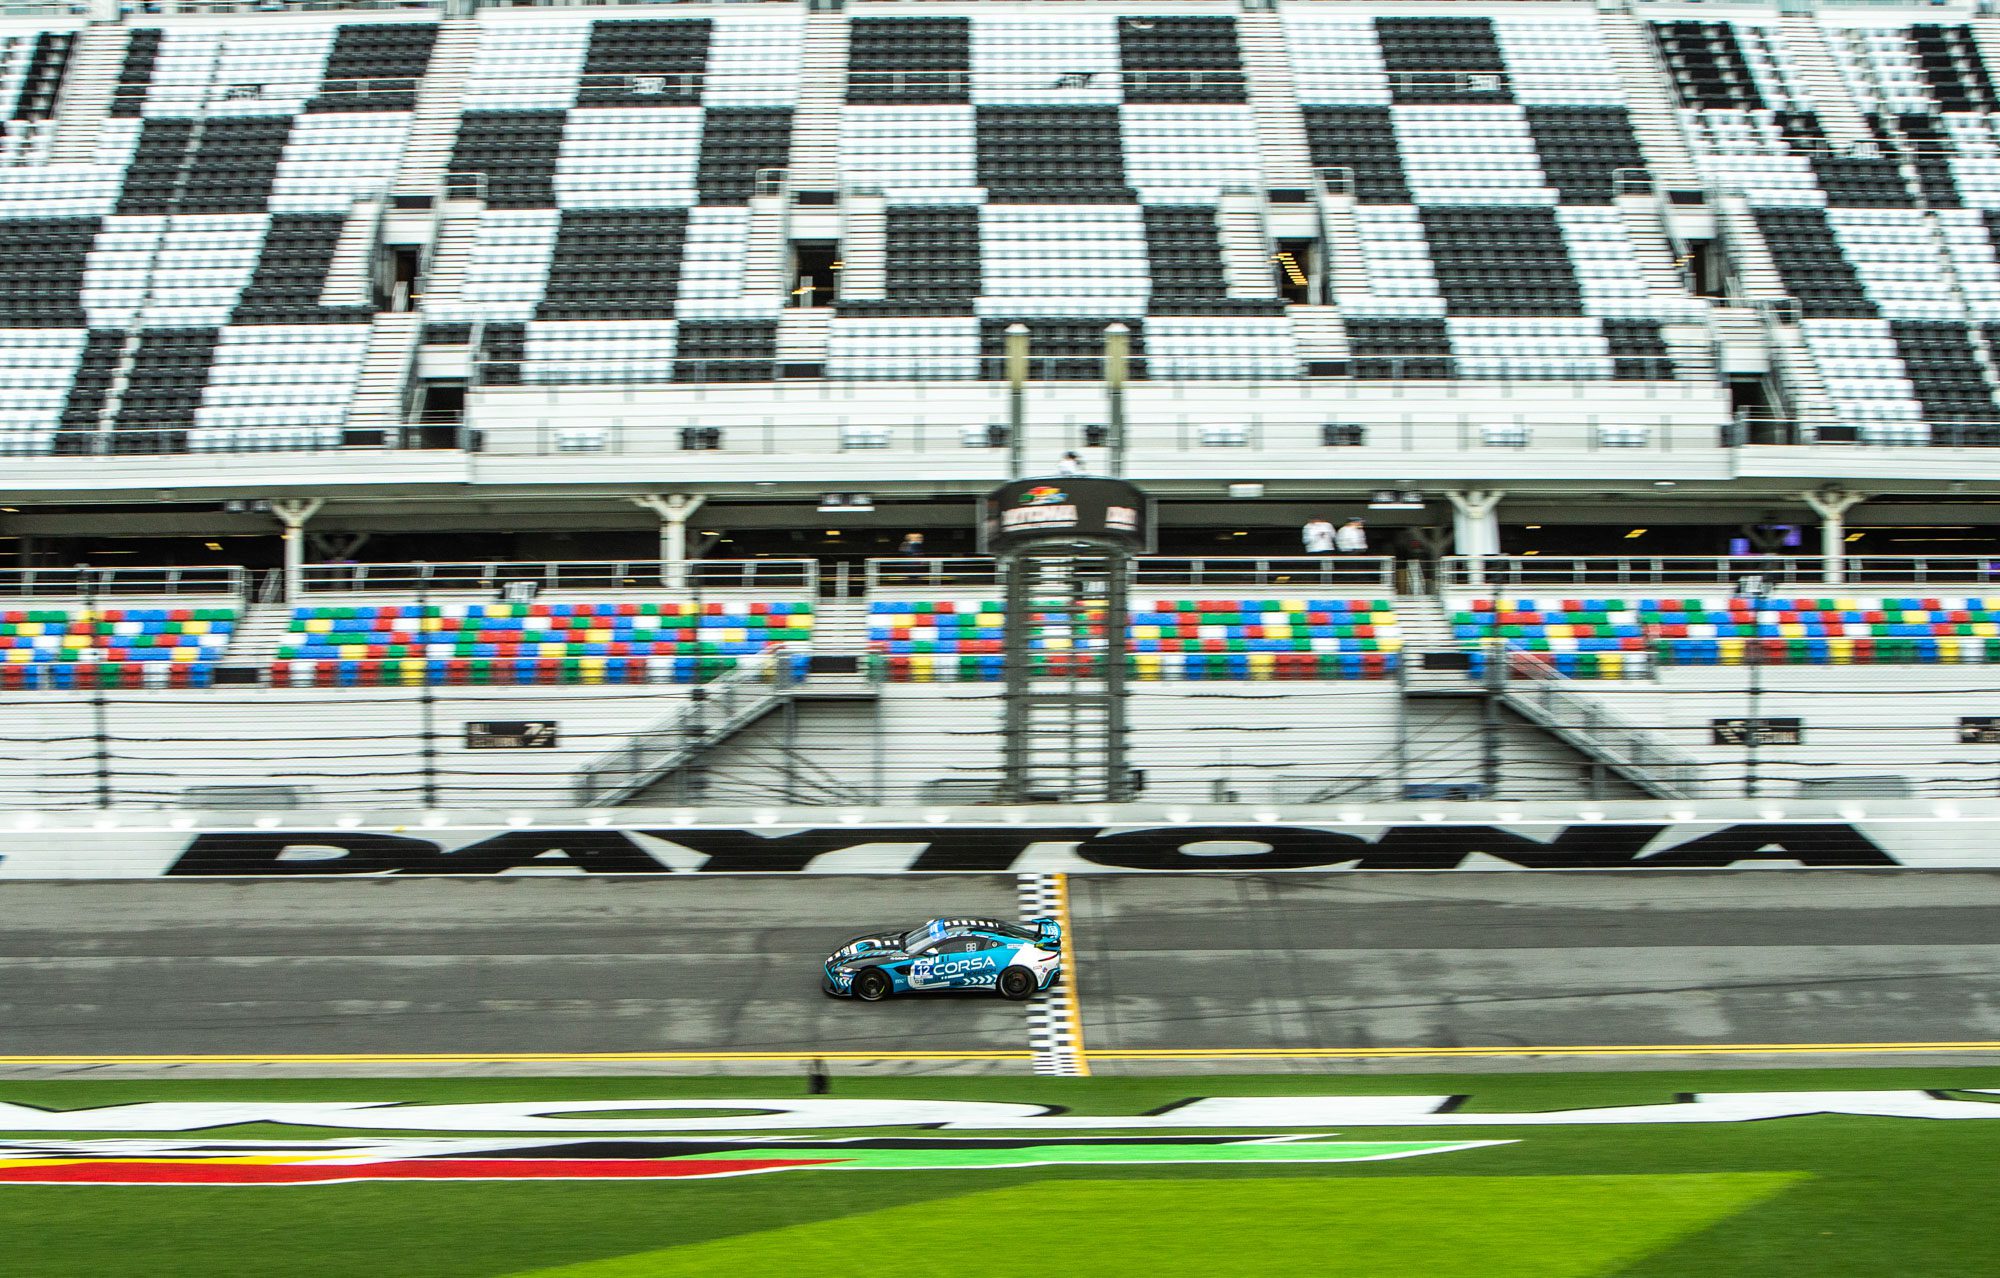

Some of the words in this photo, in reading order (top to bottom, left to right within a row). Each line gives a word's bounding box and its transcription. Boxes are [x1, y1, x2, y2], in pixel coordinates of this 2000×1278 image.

[160, 823, 1904, 876] DAYTONA
[917, 965, 930, 976] 12
[933, 956, 996, 975] CORSA
